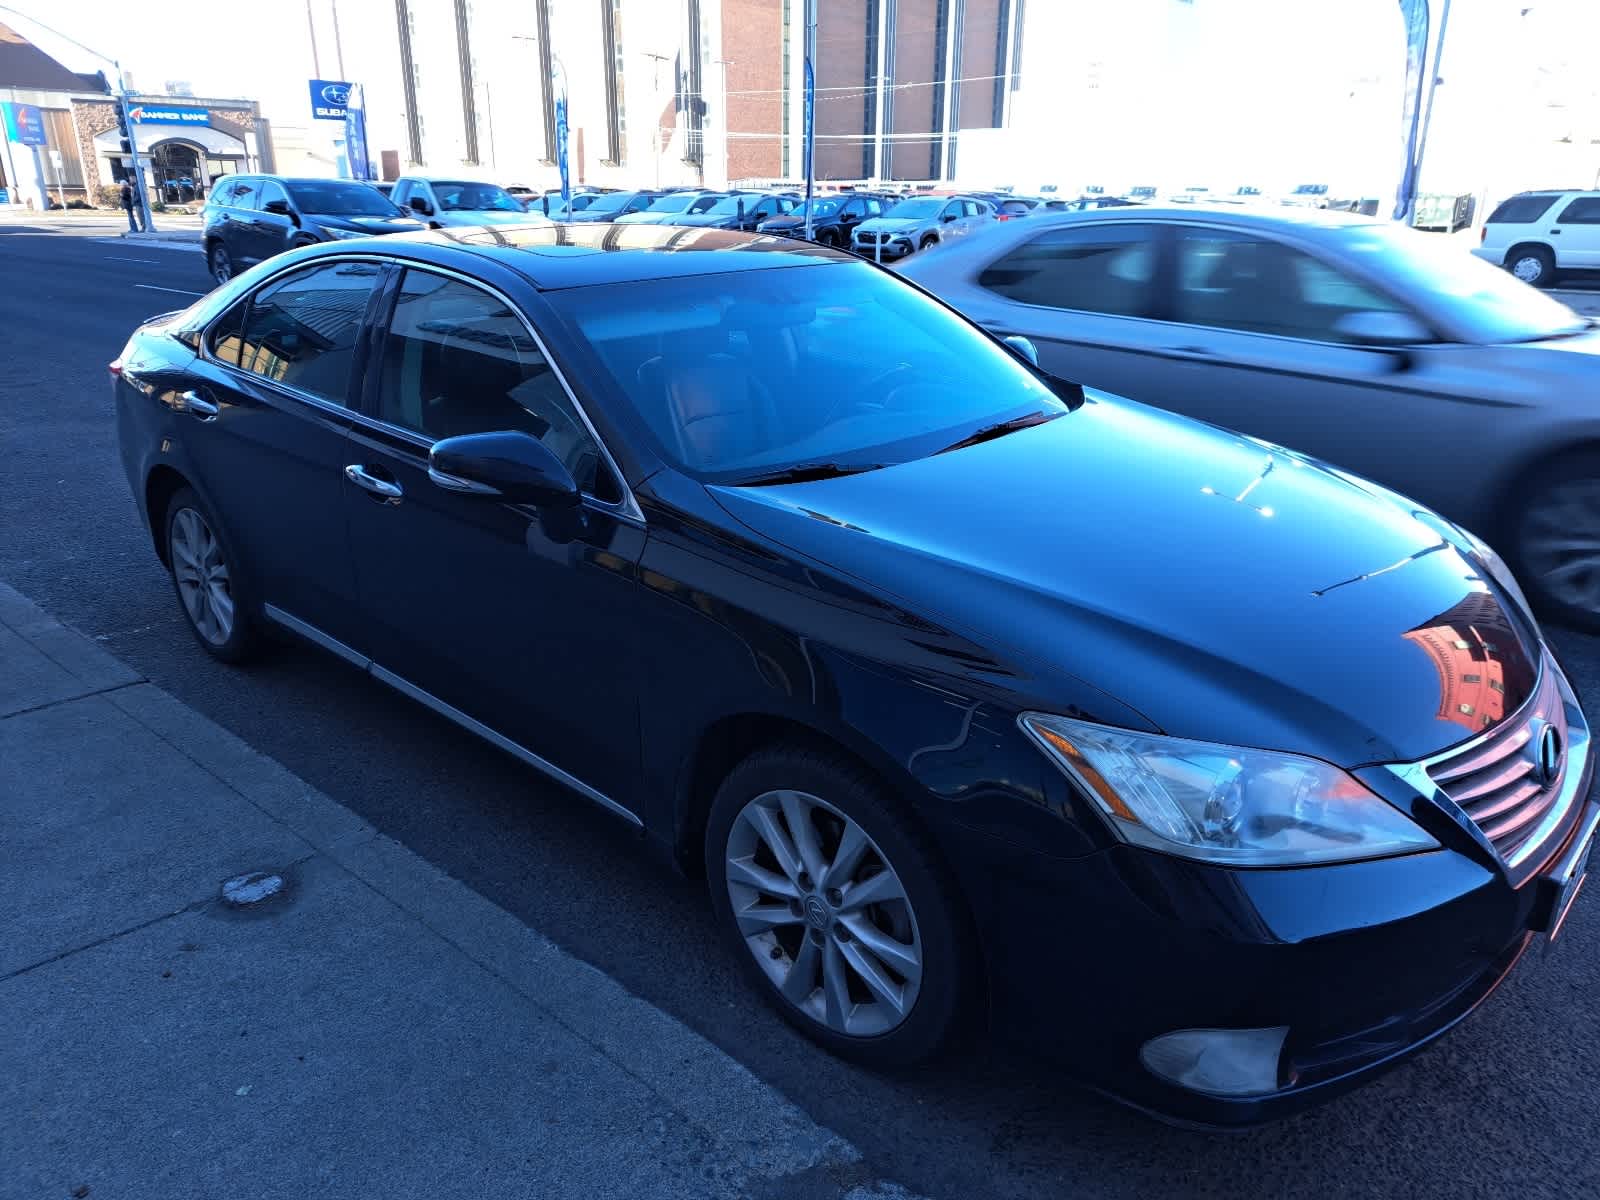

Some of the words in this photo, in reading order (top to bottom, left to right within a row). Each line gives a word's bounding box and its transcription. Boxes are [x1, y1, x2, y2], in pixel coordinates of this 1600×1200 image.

[141, 111, 180, 120] BANNER
[181, 113, 209, 121] BANK
[316, 107, 347, 117] SUBA
